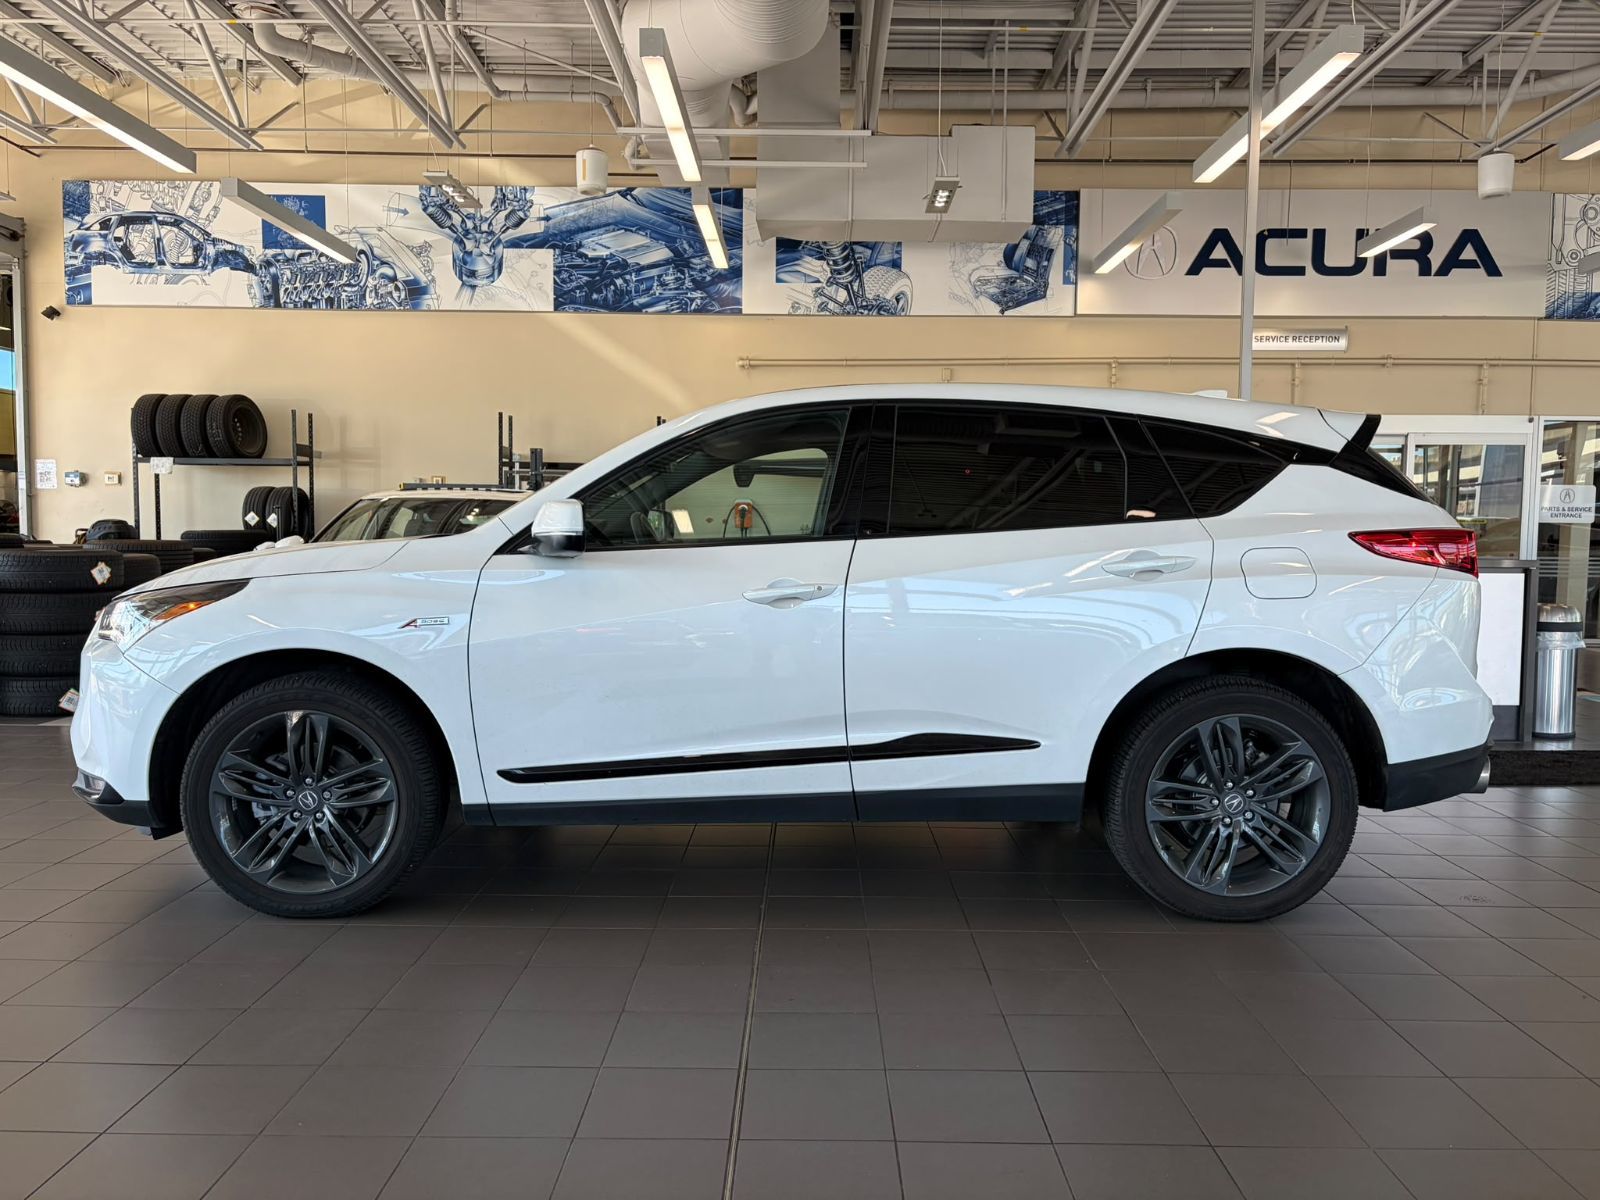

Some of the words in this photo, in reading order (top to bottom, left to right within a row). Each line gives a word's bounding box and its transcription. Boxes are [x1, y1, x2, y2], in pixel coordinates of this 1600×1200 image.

[1184, 228, 1503, 276] ACURA
[1254, 335, 1289, 343] SERVICE
[1291, 335, 1340, 343] RECEPTION
